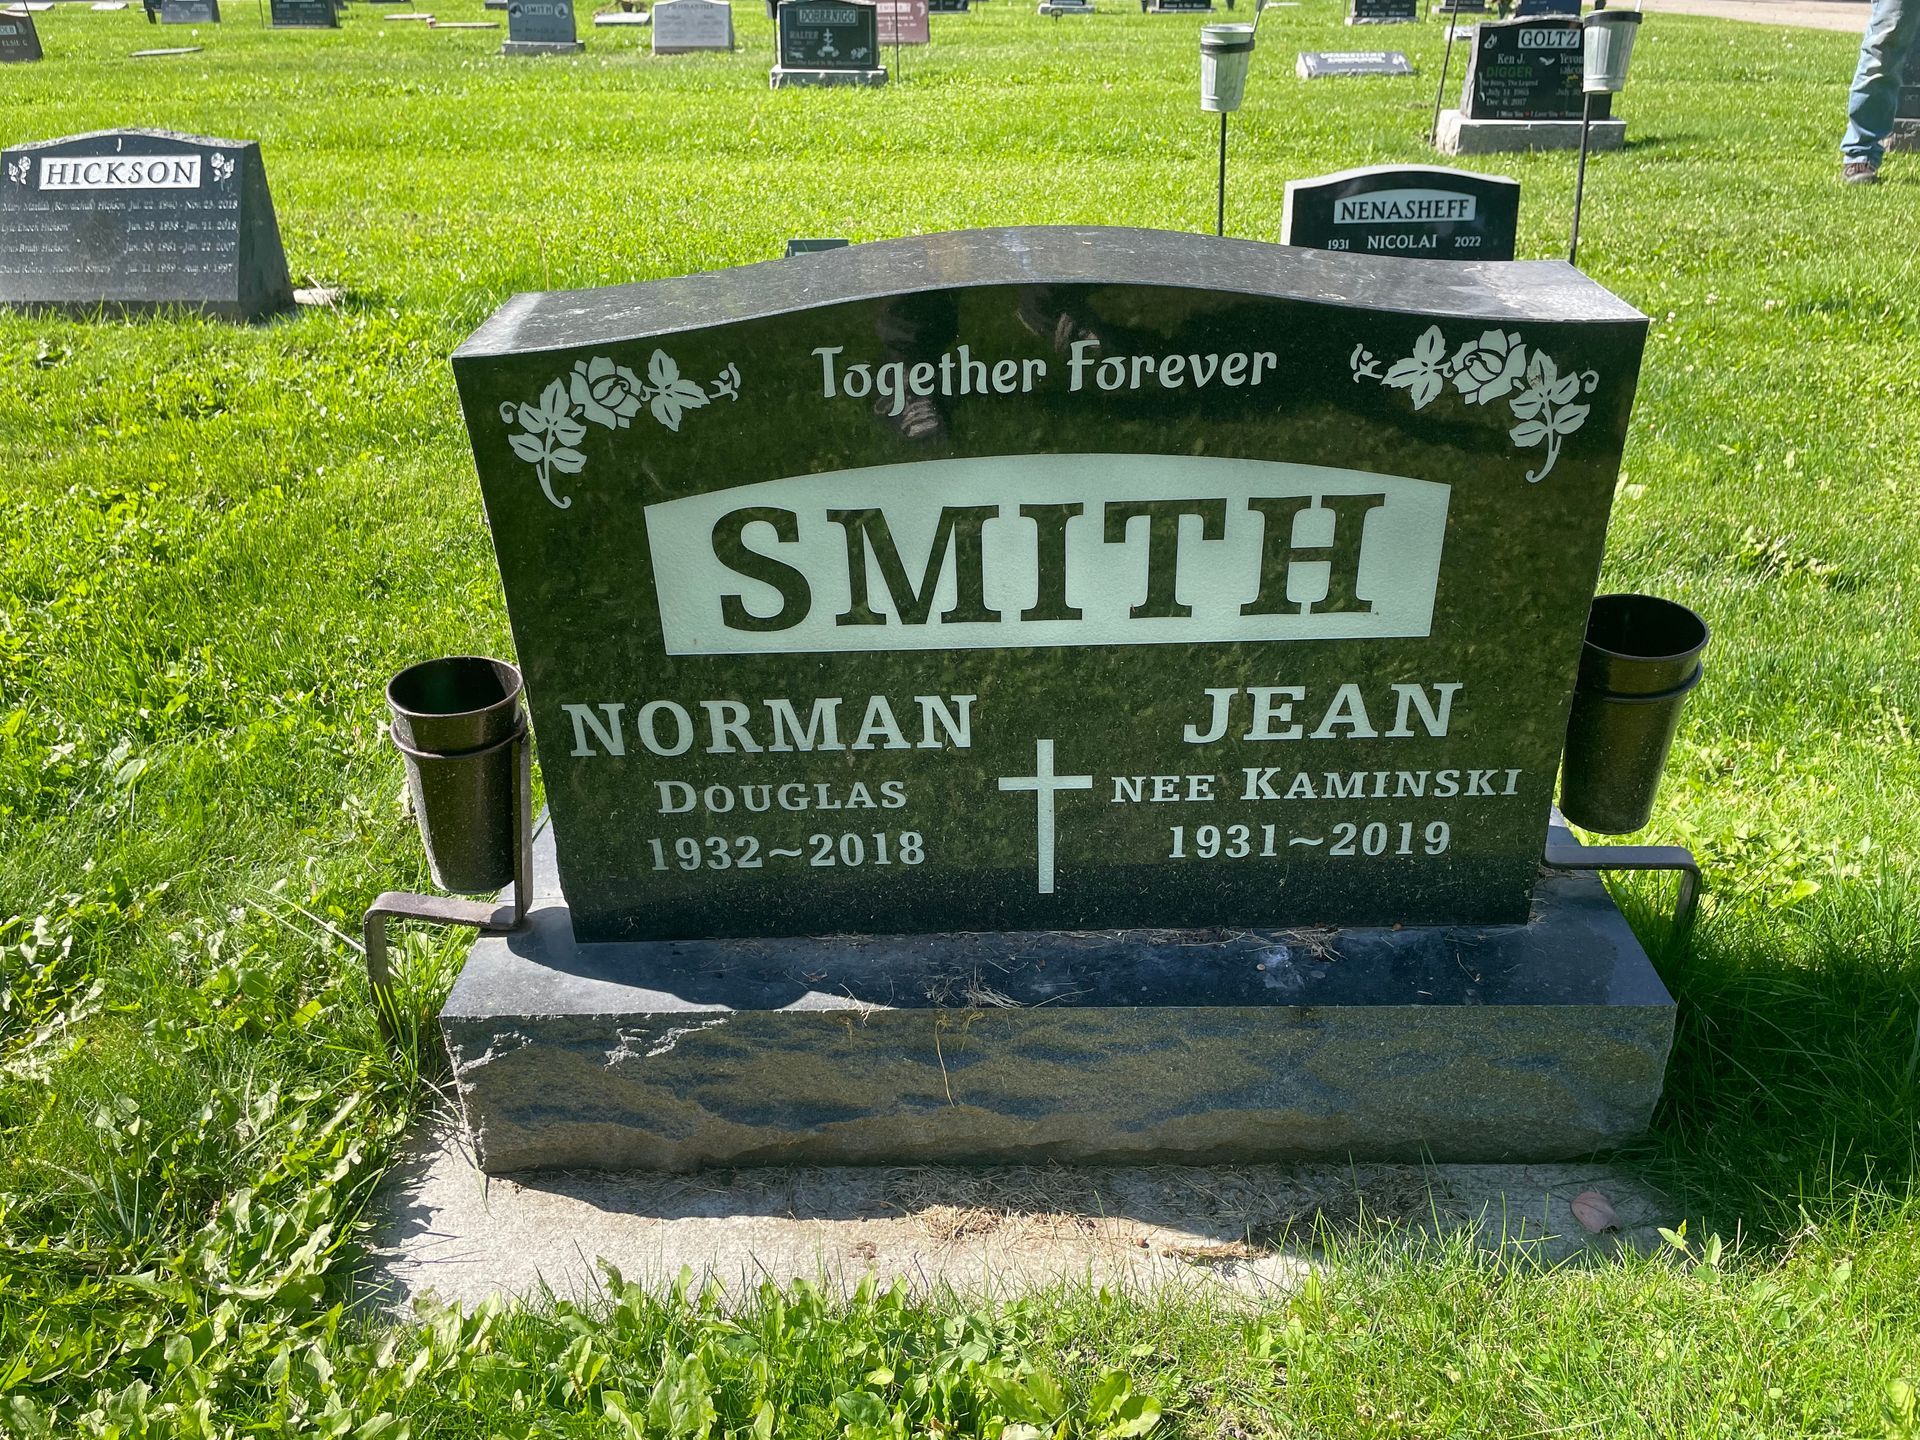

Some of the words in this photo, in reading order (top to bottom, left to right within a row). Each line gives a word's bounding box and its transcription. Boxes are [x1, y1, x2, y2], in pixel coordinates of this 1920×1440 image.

[1520, 31, 1578, 47] GOLTZ
[1486, 66, 1533, 78] DIGGER
[1497, 53, 1515, 65] Ken
[46, 161, 196, 185] HICKSON
[1340, 199, 1470, 221] NENASHEFF
[1327, 238, 1350, 250] 1931
[1367, 234, 1438, 250] NICOLAI
[1454, 235, 1482, 248] 2022
[811, 345, 1047, 416] Together
[1067, 339, 1278, 392] Forever
[711, 493, 1386, 632] SMITH
[561, 694, 978, 757] NORMAN
[1183, 681, 1463, 744] JEAN
[656, 780, 909, 814] DOUGLAS
[1111, 774, 1216, 803] NEE
[1240, 766, 1523, 801] KAMINSKI
